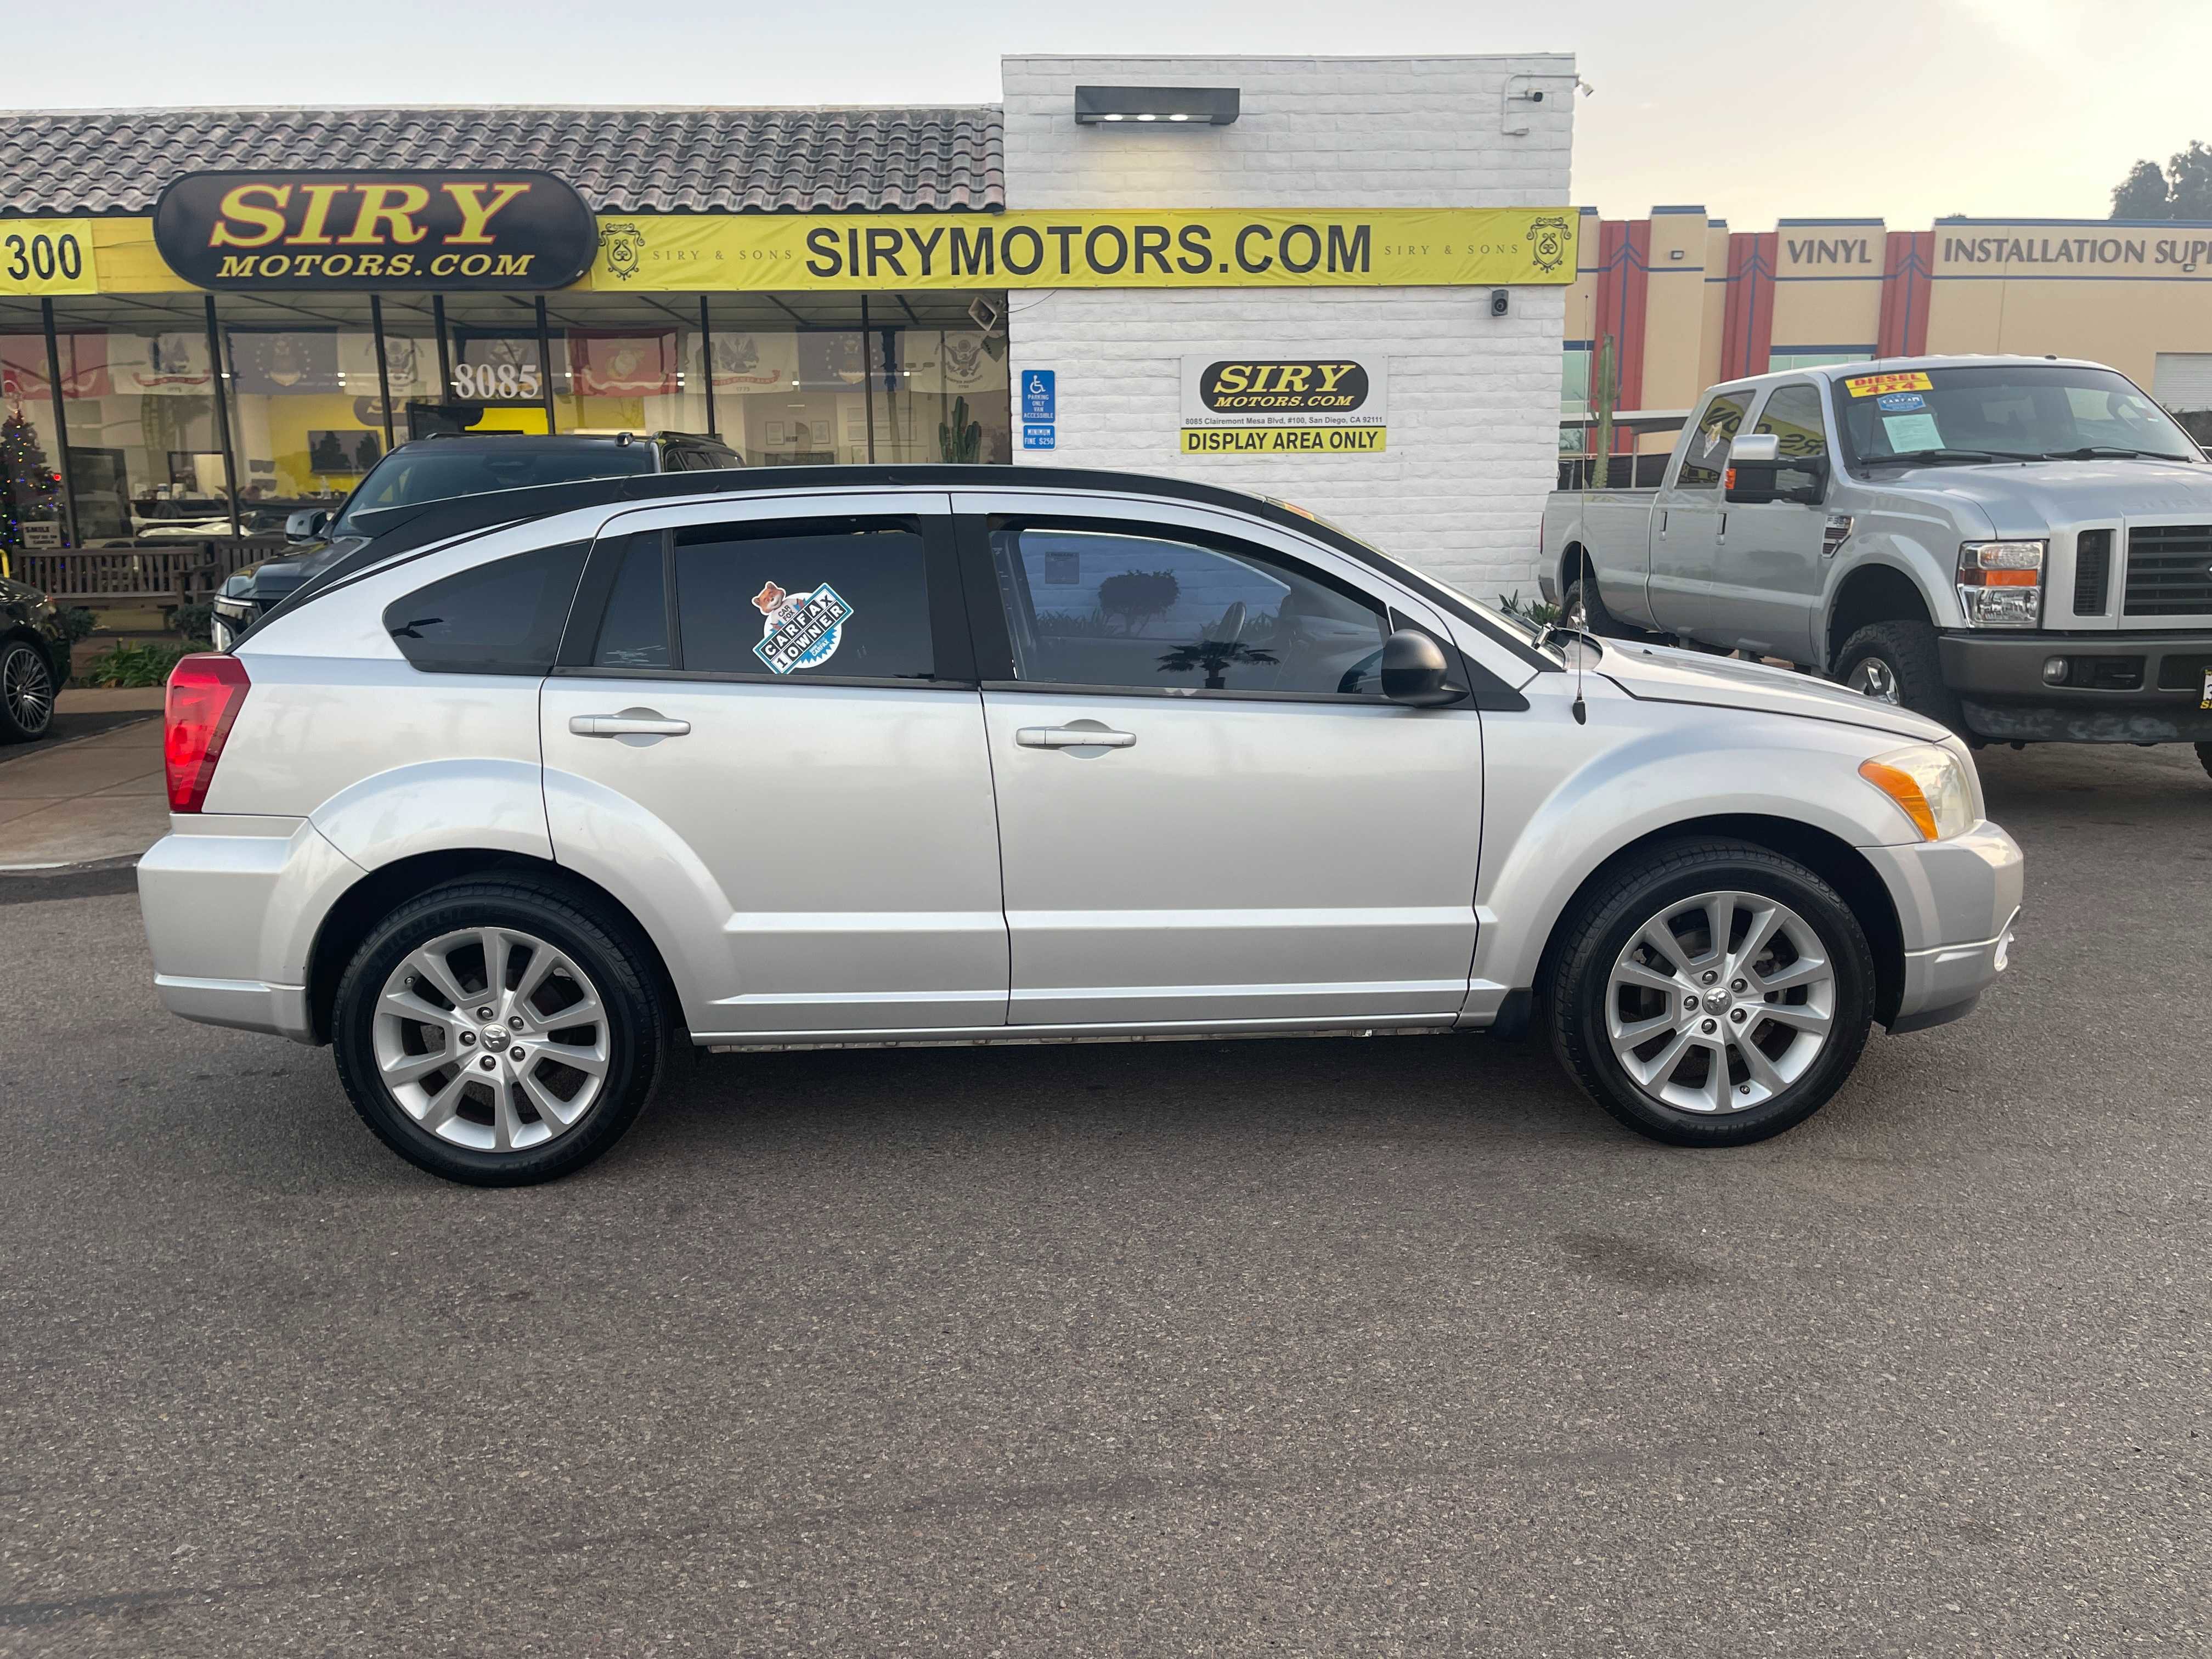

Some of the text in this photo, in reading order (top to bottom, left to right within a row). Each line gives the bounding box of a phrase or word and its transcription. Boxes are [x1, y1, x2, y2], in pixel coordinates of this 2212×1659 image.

[208, 182, 532, 246] SIRY
[653, 250, 792, 260] SIRY & SONS
[806, 224, 1370, 278] SIRYMOTORS.COM
[1384, 244, 1519, 255] SIRY & SONS
[1788, 239, 1872, 264] VINYL
[1944, 238, 2146, 263] INSTALLATION
[216, 254, 535, 278] MOTORS.COM
[455, 363, 538, 399] 8085
[1213, 364, 1356, 393] SIRY
[1854, 374, 1921, 386] DIESEL
[1214, 395, 1355, 408] MOTORS.COM
[1188, 431, 1379, 450] DISPLAY AREA ONLY
[778, 605, 791, 617] CAR
[782, 611, 795, 622] FOX
[765, 594, 833, 656] CARFAX
[776, 657, 788, 669] 1
[787, 604, 844, 658] OWNER
